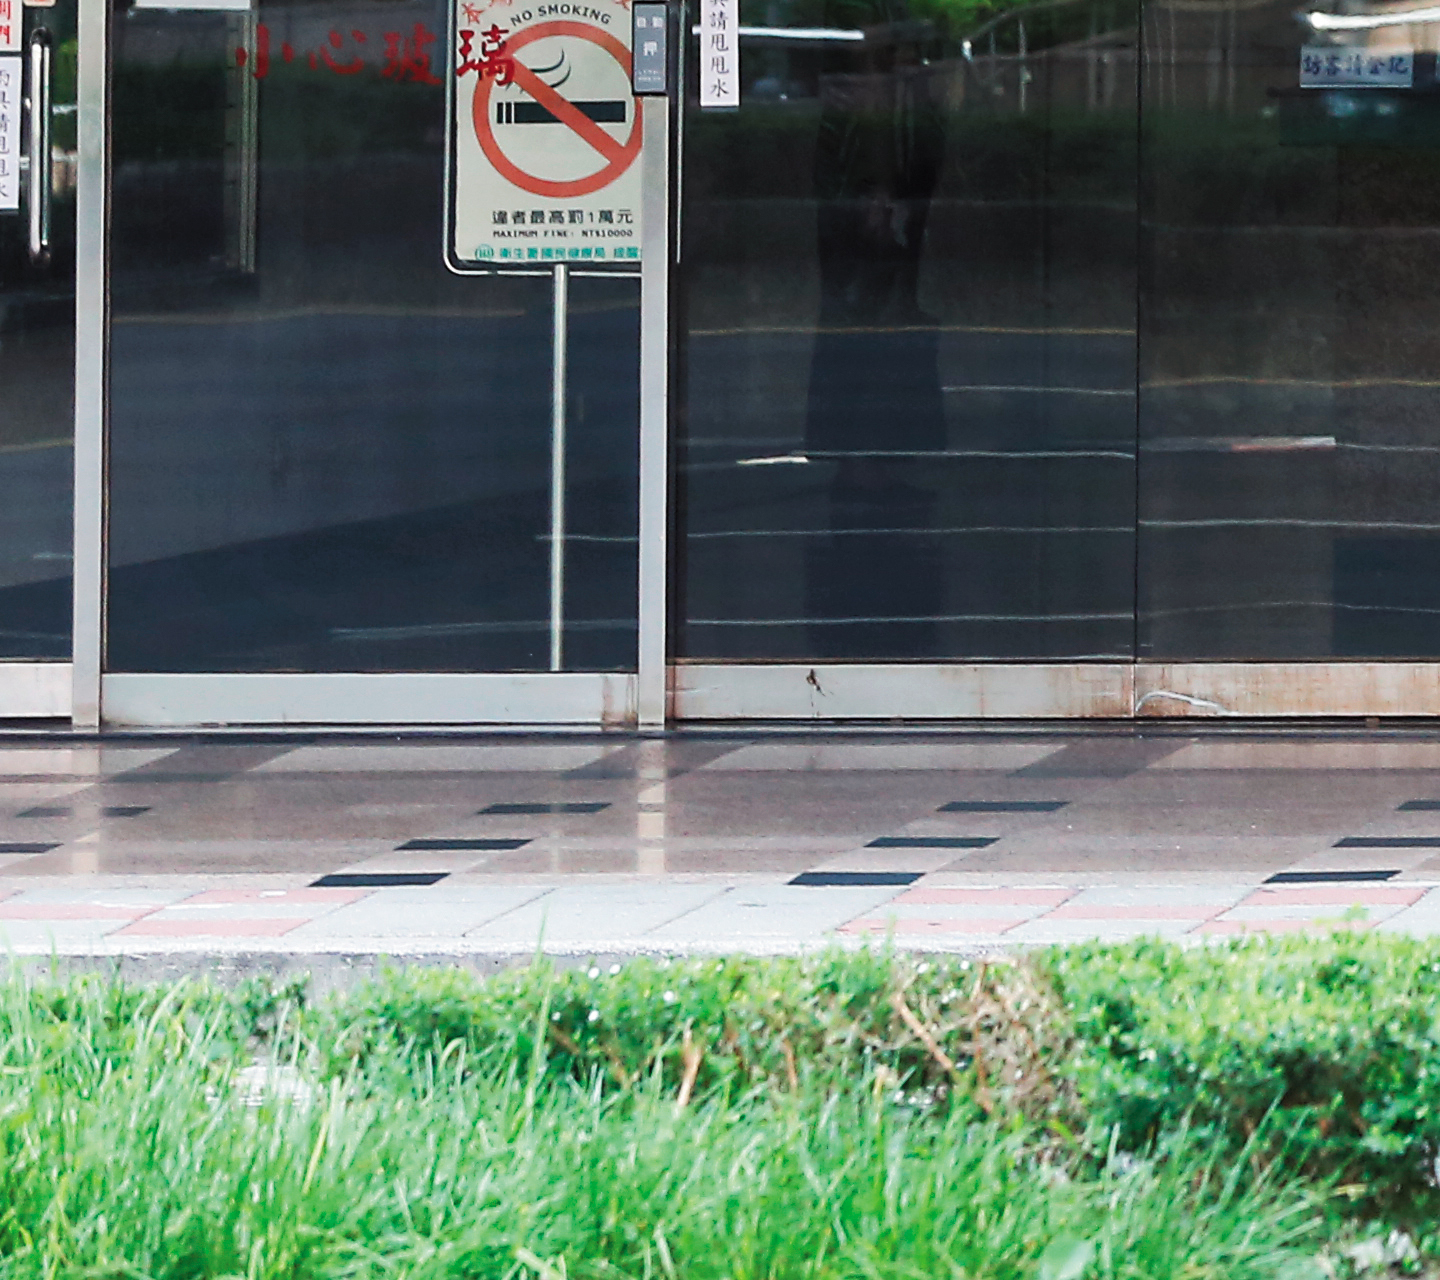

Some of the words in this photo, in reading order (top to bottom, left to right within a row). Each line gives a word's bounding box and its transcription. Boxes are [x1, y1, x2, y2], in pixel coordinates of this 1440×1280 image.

[510, 11, 533, 27] NO
[538, 3, 612, 25] SMOKING
[236, 23, 515, 85] 小心玻璃
